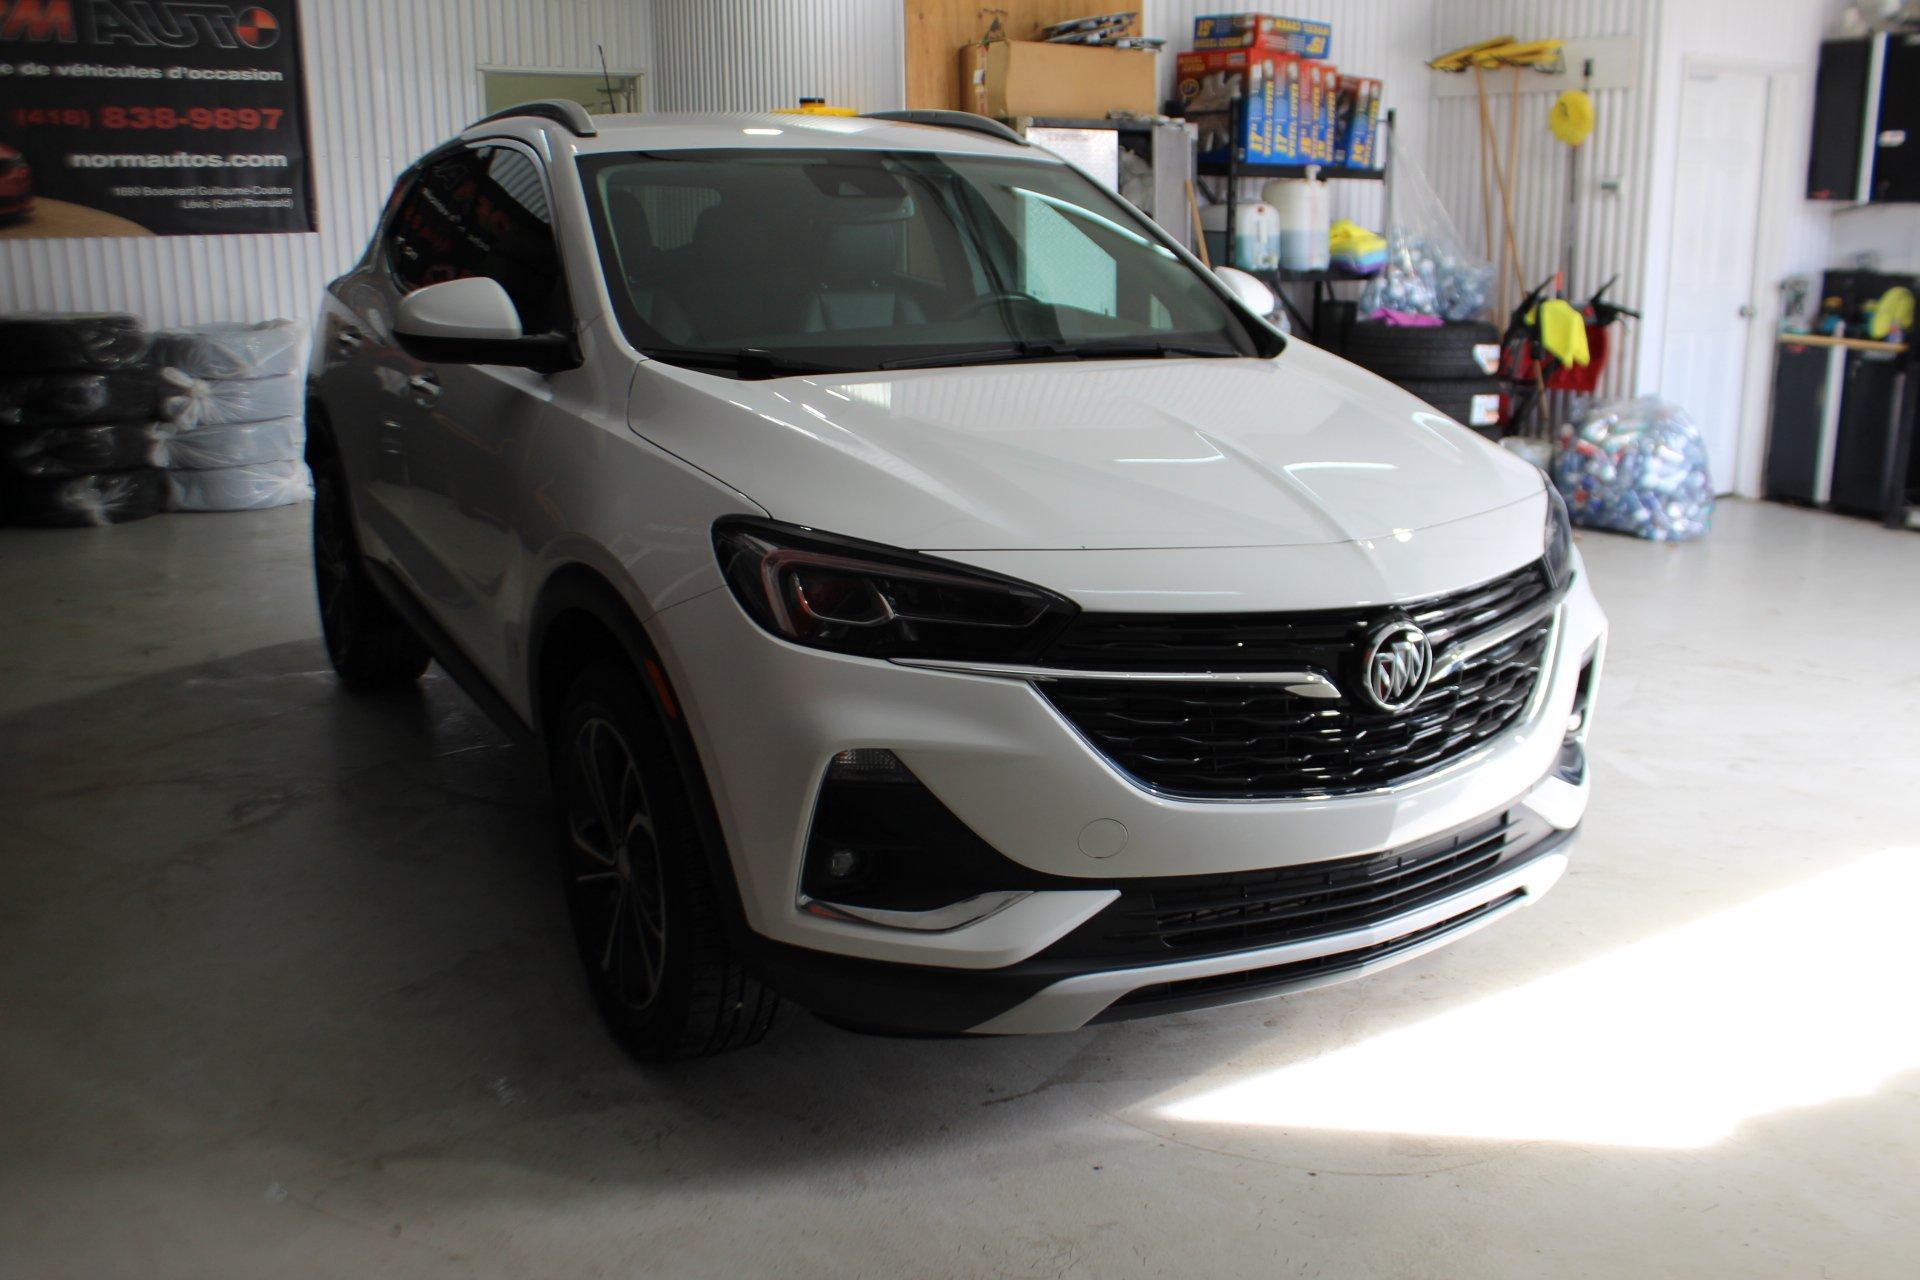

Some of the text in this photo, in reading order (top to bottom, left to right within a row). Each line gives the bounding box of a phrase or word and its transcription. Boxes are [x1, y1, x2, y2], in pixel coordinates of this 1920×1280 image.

[19, 62, 51, 76] de
[56, 63, 162, 79] véhicules
[167, 65, 284, 81] d'occasion
[101, 106, 284, 130] 838-9897
[71, 151, 288, 169] normautos.com
